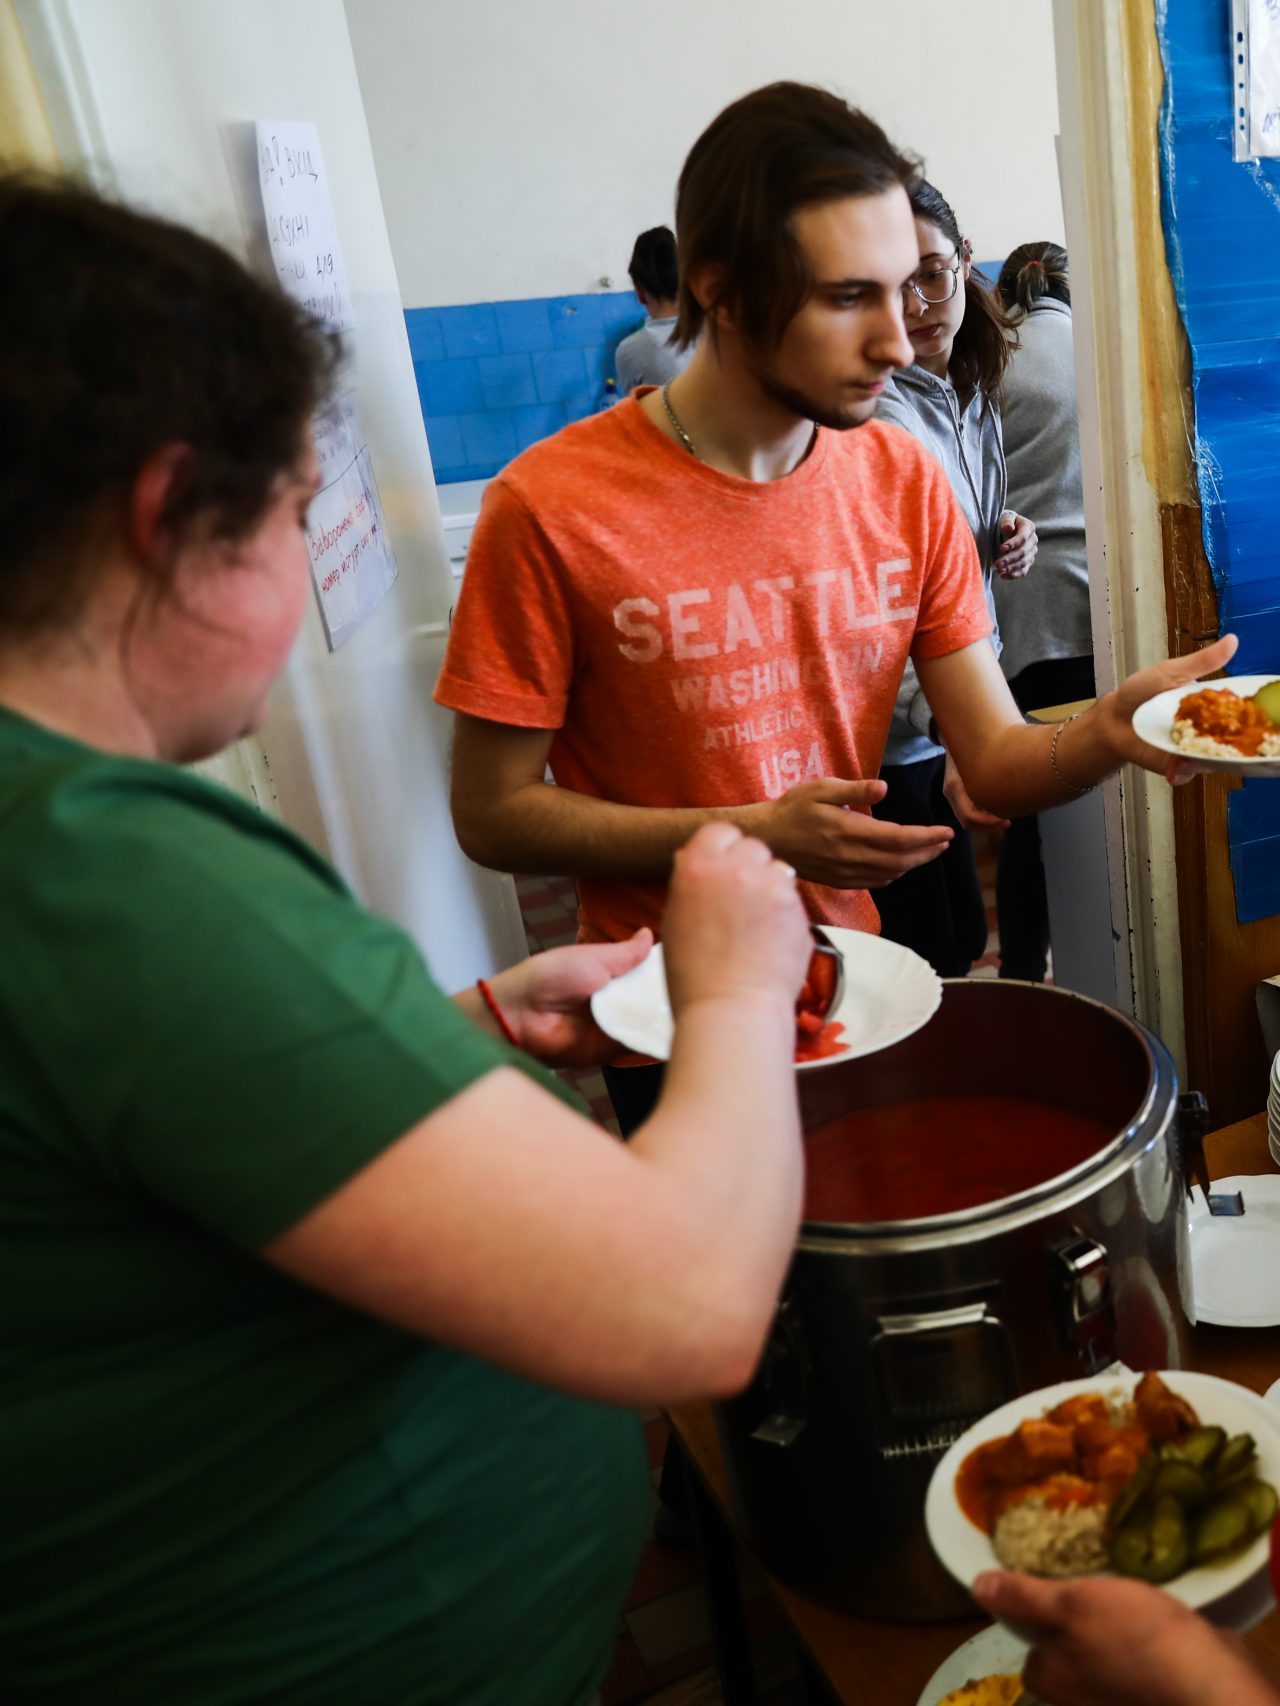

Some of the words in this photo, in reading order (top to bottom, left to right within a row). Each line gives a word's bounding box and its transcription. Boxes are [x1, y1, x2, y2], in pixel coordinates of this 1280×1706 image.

[612, 558, 919, 663] SEATTLE
[703, 703, 803, 751] ATHLETIC
[760, 741, 826, 800] USA
